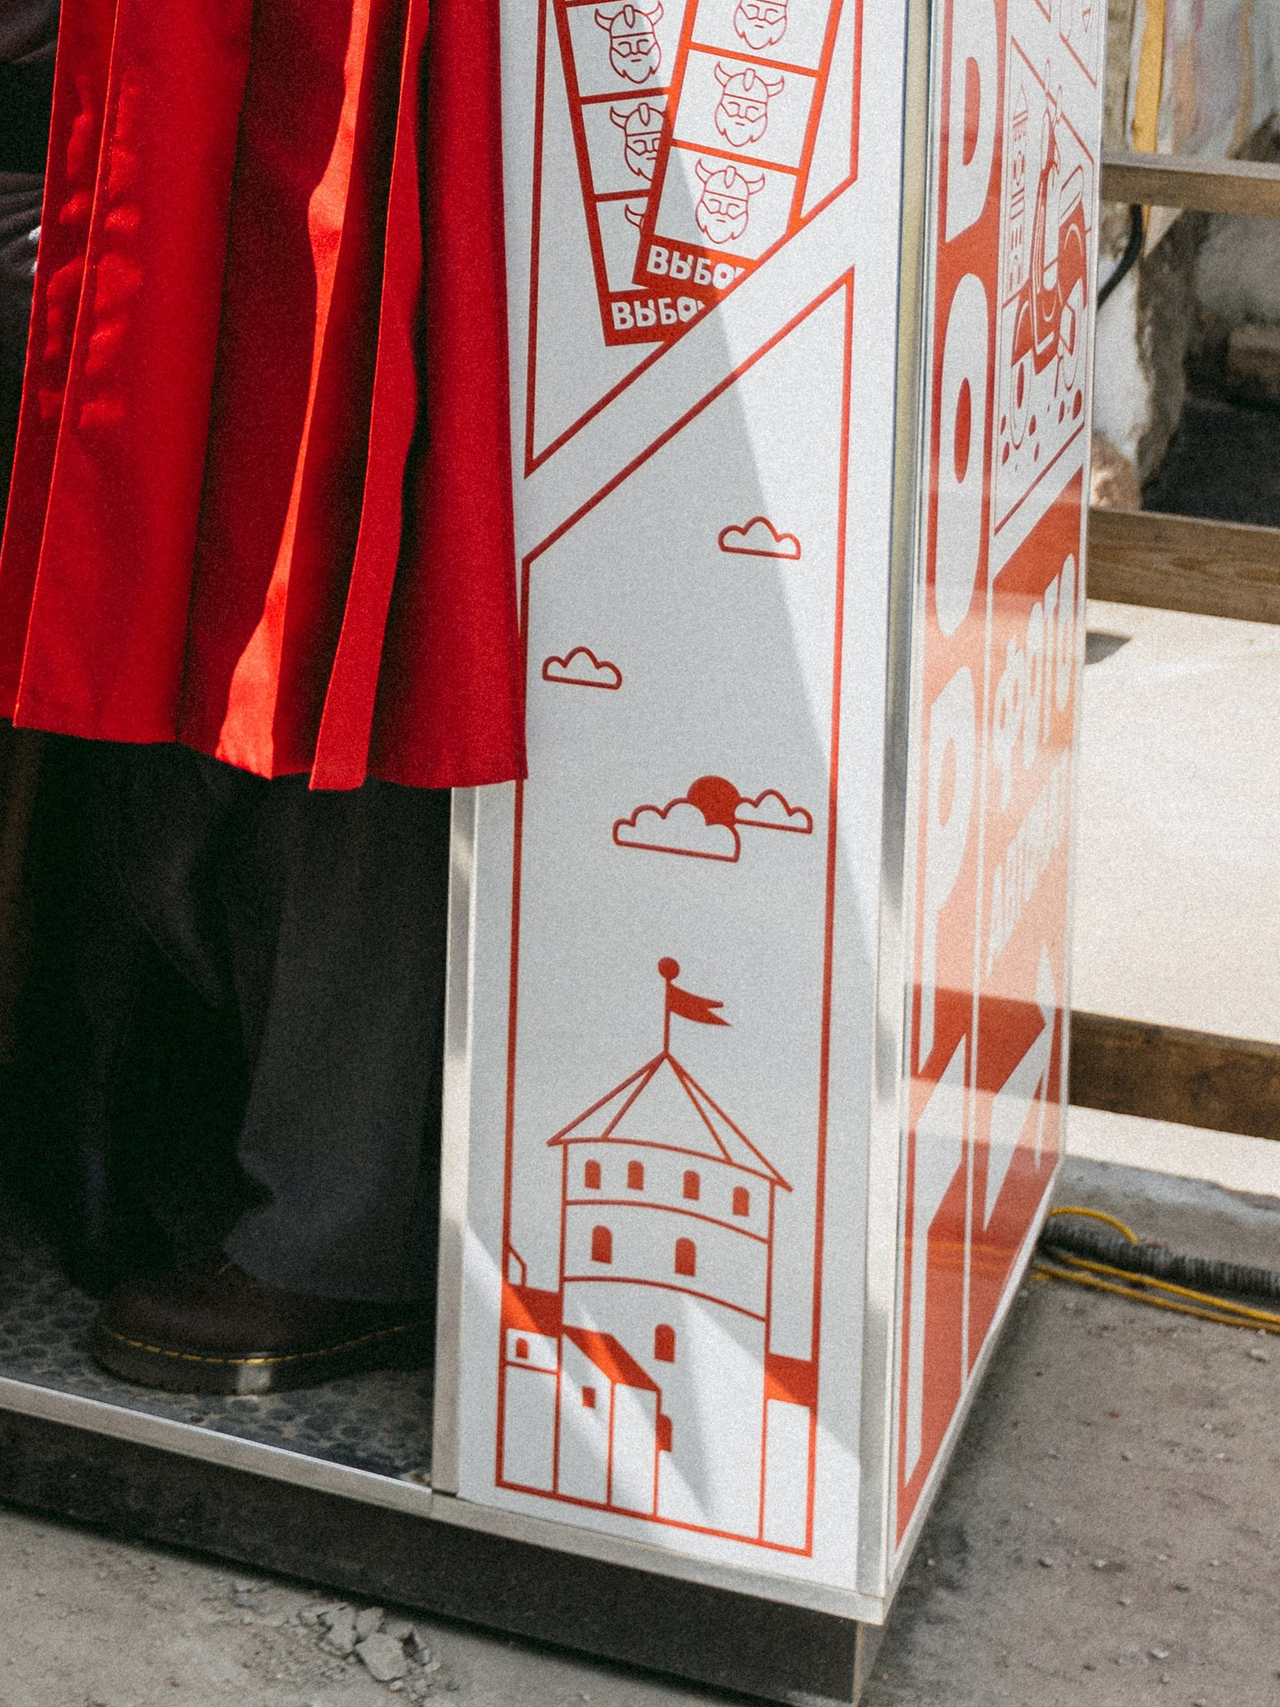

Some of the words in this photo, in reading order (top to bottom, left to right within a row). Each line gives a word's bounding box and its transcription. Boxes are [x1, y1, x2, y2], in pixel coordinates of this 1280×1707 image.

[646, 245, 745, 289] ВЫБО
[611, 296, 705, 330] ВЫБО
[993, 552, 1074, 811] ФОТО
